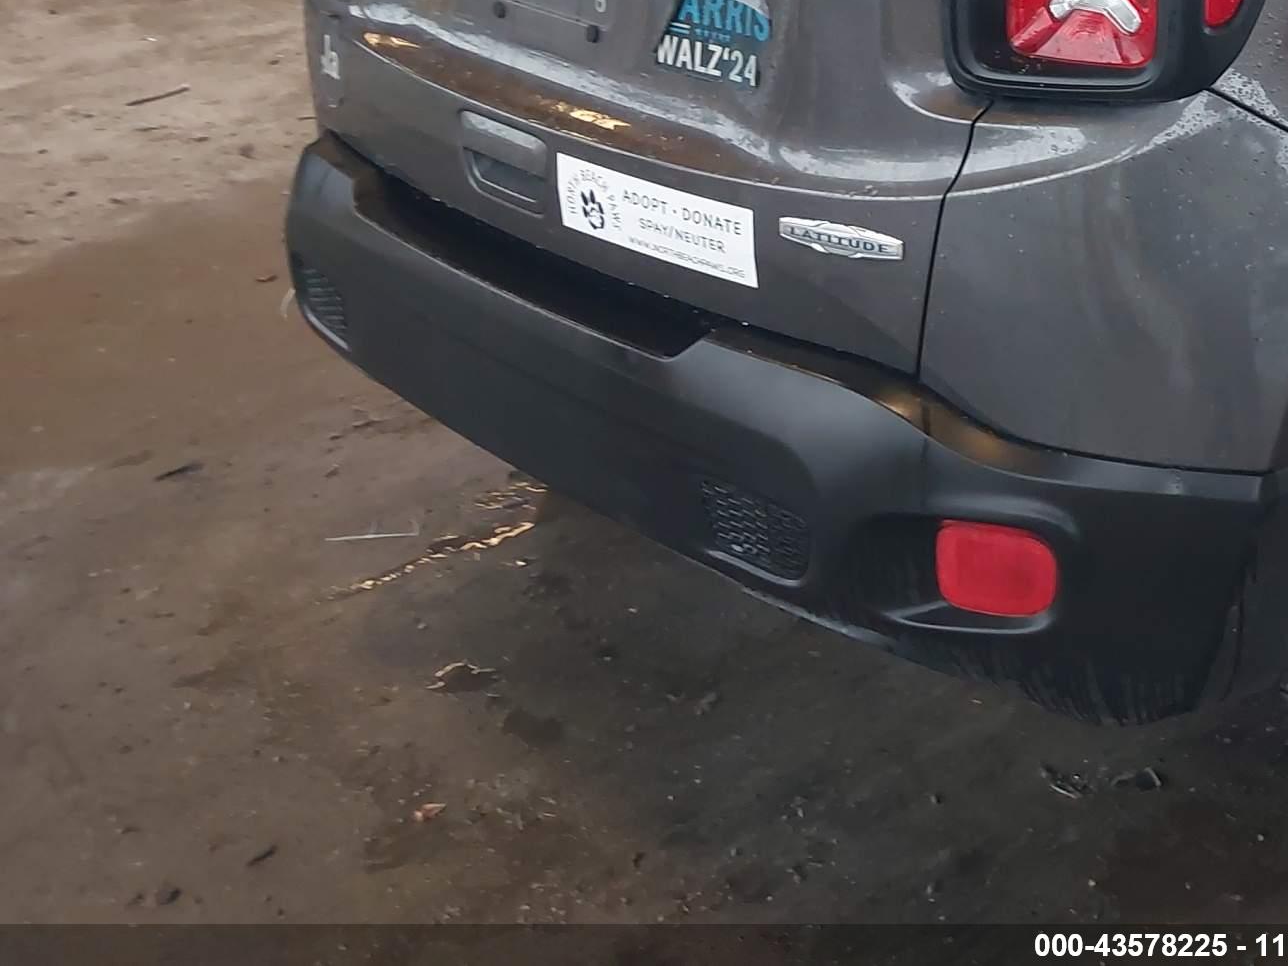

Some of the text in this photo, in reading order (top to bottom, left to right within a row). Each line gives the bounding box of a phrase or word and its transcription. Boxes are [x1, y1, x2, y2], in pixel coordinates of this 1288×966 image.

[622, 189, 742, 236] ADOPT DONATE
[638, 217, 727, 254] SPAY/NEUTER
[790, 226, 890, 253] LATITUDE
